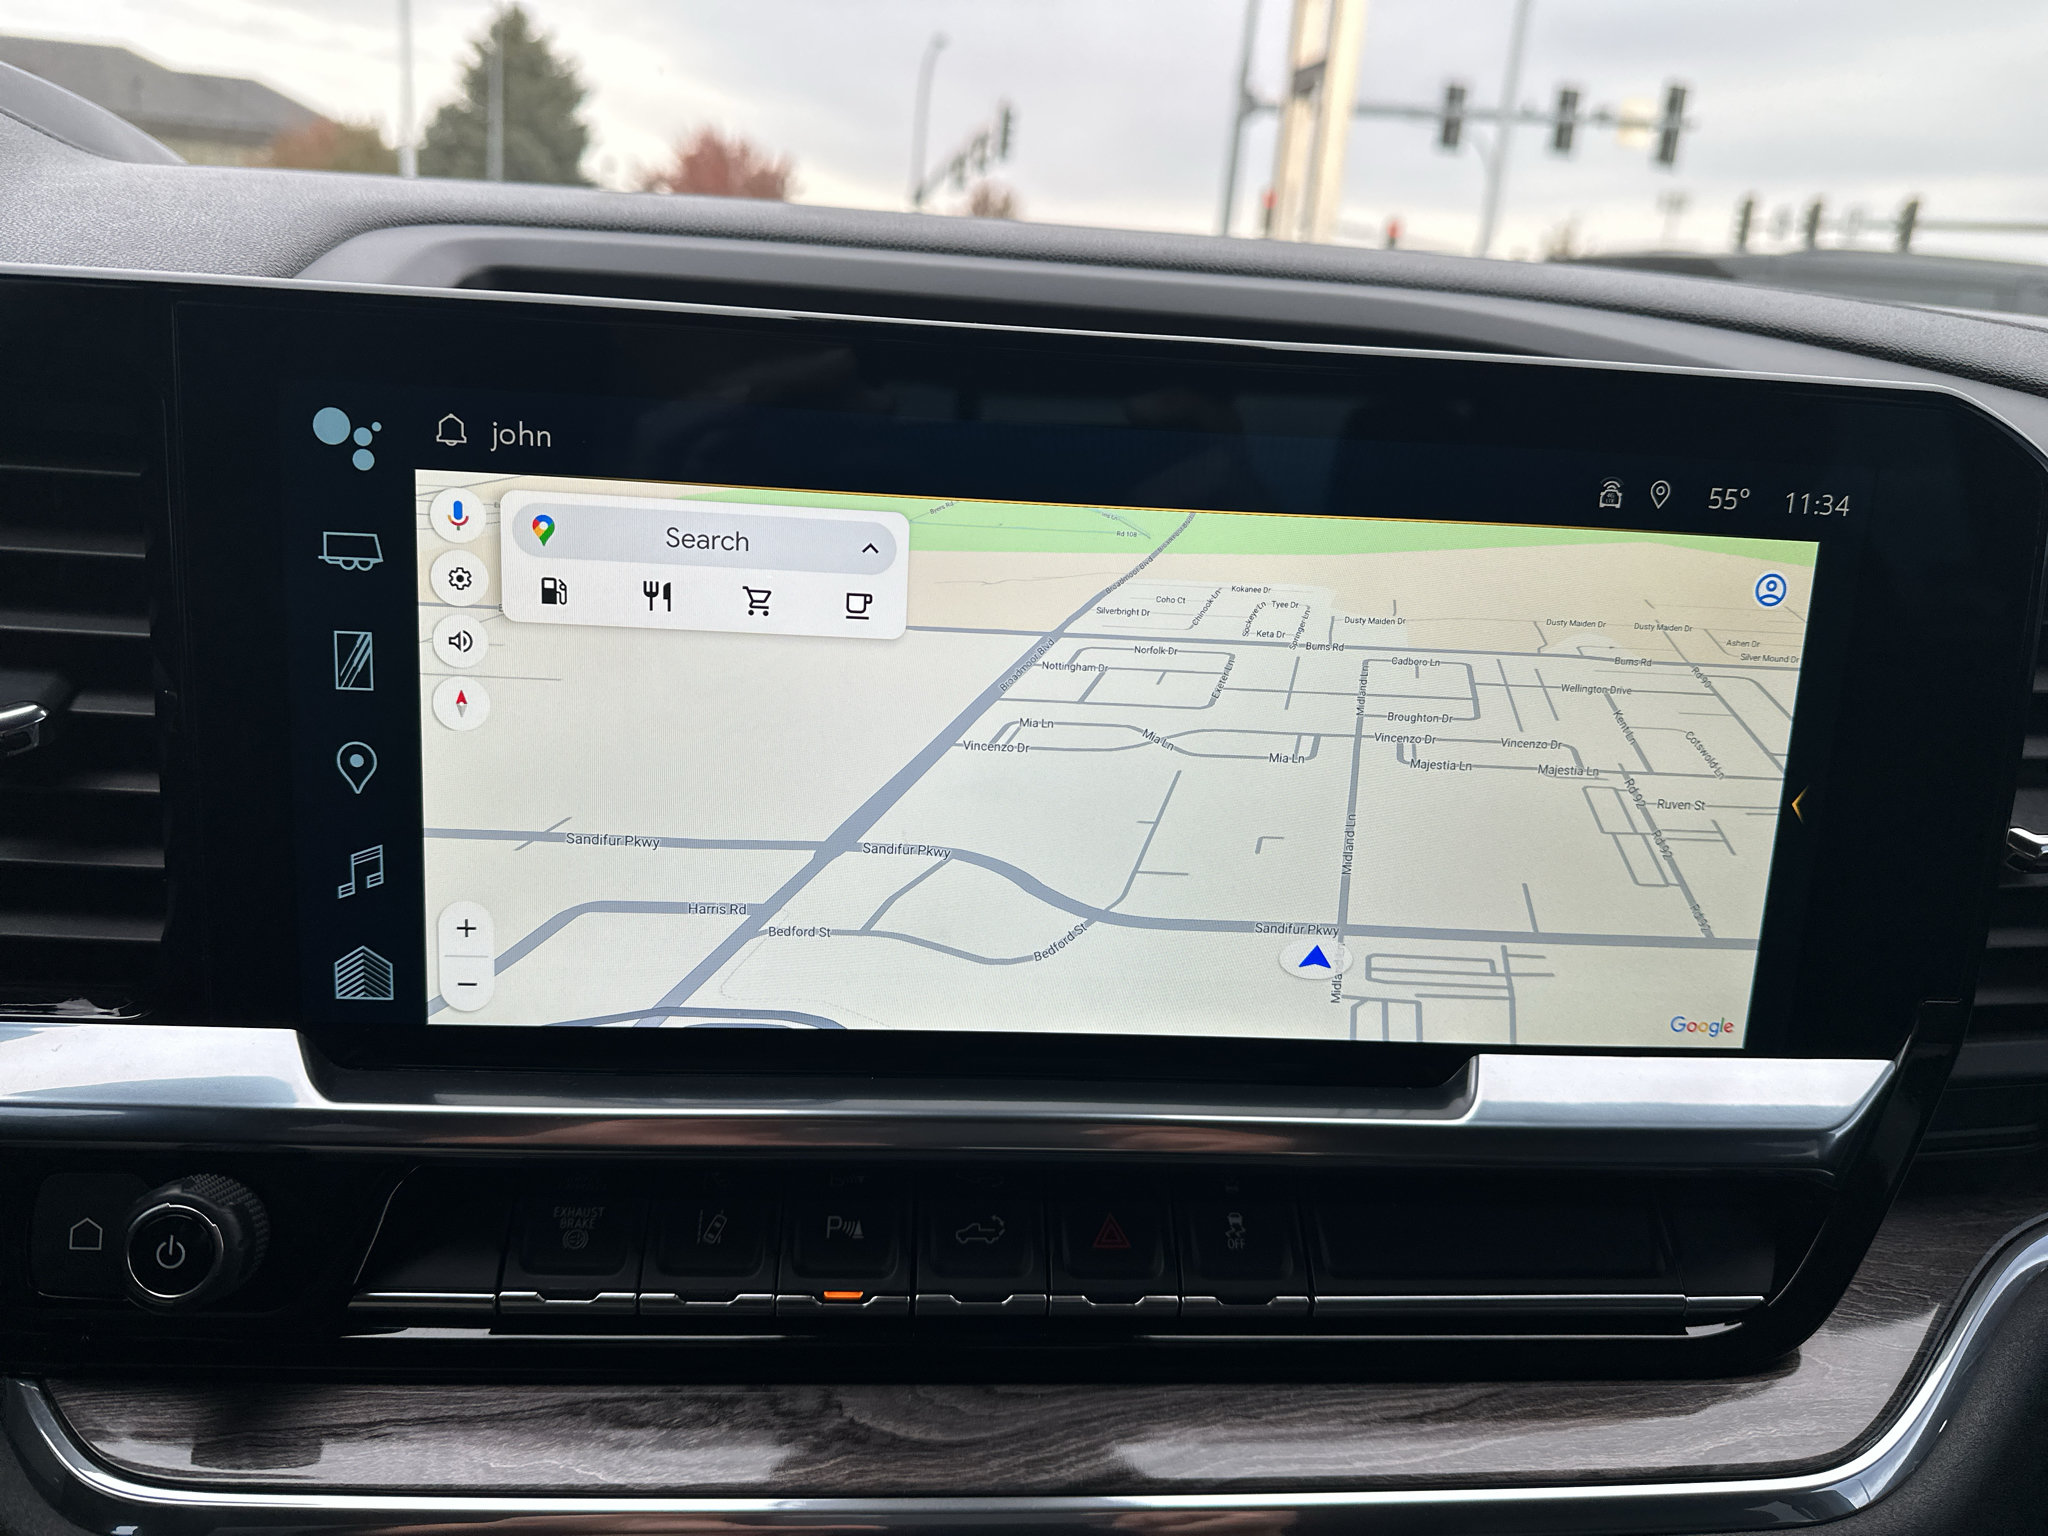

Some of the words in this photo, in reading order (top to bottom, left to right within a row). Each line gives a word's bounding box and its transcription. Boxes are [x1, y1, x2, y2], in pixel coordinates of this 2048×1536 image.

[490, 421, 551, 452] john
[1785, 492, 1850, 517] 11:34
[665, 526, 749, 552] Search
[1105, 566, 1140, 594] Broadmoor
[1139, 556, 1154, 570] Blvd
[1231, 585, 1261, 594] Kokanee
[1156, 596, 1175, 604] Coho
[1272, 601, 1288, 610] Tyee
[1096, 607, 1139, 618] Silverbright
[1141, 609, 1150, 617] Dr
[1192, 597, 1214, 626] Chinook
[1211, 588, 1221, 598] Ln
[1242, 607, 1259, 637] Sockeye
[1257, 601, 1266, 610] Ln
[1344, 616, 1366, 625] Dusty
[1368, 617, 1395, 625] Maiden
[1397, 617, 1406, 625] Dr
[1546, 619, 1567, 628] Dusty
[1569, 619, 1596, 628] Maiden
[1598, 620, 1606, 628] Dr
[1289, 619, 1306, 650] Springer
[1303, 606, 1311, 619] Ln
[1634, 623, 1654, 632] Dusty
[1656, 624, 1682, 632] Maiden
[1257, 631, 1274, 639] Keta
[1276, 631, 1286, 639] Dr
[1134, 646, 1166, 655] Norfolk
[1168, 647, 1178, 655] Dr
[1332, 643, 1344, 651] Rd
[1429, 658, 1440, 666] Ln
[1740, 653, 1759, 662] Silver
[1762, 654, 1788, 662] Mound
[1000, 653, 1039, 692] Broadmoor
[1036, 638, 1055, 657] Blvd
[1041, 661, 1096, 673] Nottingham
[1098, 664, 1108, 672] Dr
[1360, 665, 1369, 677] Ln
[1212, 670, 1230, 699] Exeter
[1225, 655, 1235, 670] Ln
[1691, 667, 1704, 679] Rd
[1701, 676, 1712, 688] 90
[1561, 684, 1608, 695] Wellington
[1610, 686, 1632, 694] Drive
[1356, 677, 1369, 717] Midland
[1019, 718, 1036, 728] Mia
[1041, 719, 1054, 728] Ln
[1387, 712, 1439, 725] Broughton
[1441, 714, 1453, 724] Dr
[1613, 710, 1630, 734] Kent
[1625, 731, 1637, 745] Ln
[1142, 728, 1161, 743] Mia
[1159, 737, 1174, 750] Ln
[1375, 733, 1422, 743] Vincenzo
[1424, 735, 1436, 744] Dr
[1501, 738, 1547, 749] Vincenzo
[1550, 739, 1563, 750] Dr
[963, 741, 1014, 752] Vincenzo
[1017, 743, 1030, 753] Dr
[1269, 753, 1286, 763] Mia
[1291, 754, 1305, 764] Ln
[1685, 731, 1718, 769] Cotswold
[1714, 765, 1725, 780] Ln
[1410, 759, 1456, 771] Majestia
[1459, 761, 1472, 771] Ln
[1538, 765, 1584, 778] Majestia
[1586, 766, 1599, 776] Ln
[1625, 778, 1638, 794] Rd
[1633, 792, 1646, 810] 92
[1657, 799, 1691, 810] Ruven
[1692, 800, 1705, 811] St
[1346, 814, 1357, 828] Ln
[566, 833, 622, 846] Sandifur
[625, 836, 660, 850] Pkwy
[1652, 830, 1667, 848] Rd
[1661, 845, 1673, 860] 92
[862, 843, 915, 856] Sandifur
[918, 845, 951, 859] Pkwy
[1342, 830, 1355, 875] Midland
[688, 903, 726, 915] Harris
[730, 903, 747, 915] Rd
[1690, 904, 1702, 920] Rd
[768, 926, 815, 937] Bedford
[818, 927, 831, 938] St
[1255, 923, 1304, 934] Sandifur
[1308, 924, 1339, 938] Pkwy
[1034, 930, 1075, 962] Bedford
[1072, 923, 1087, 939] St
[1330, 960, 1343, 1003] Midla
[1670, 1015, 1734, 1037] Google
[553, 1206, 605, 1217] EXHAUST
[560, 1217, 595, 1228] BRAKE
[1228, 1238, 1245, 1249] OFF
